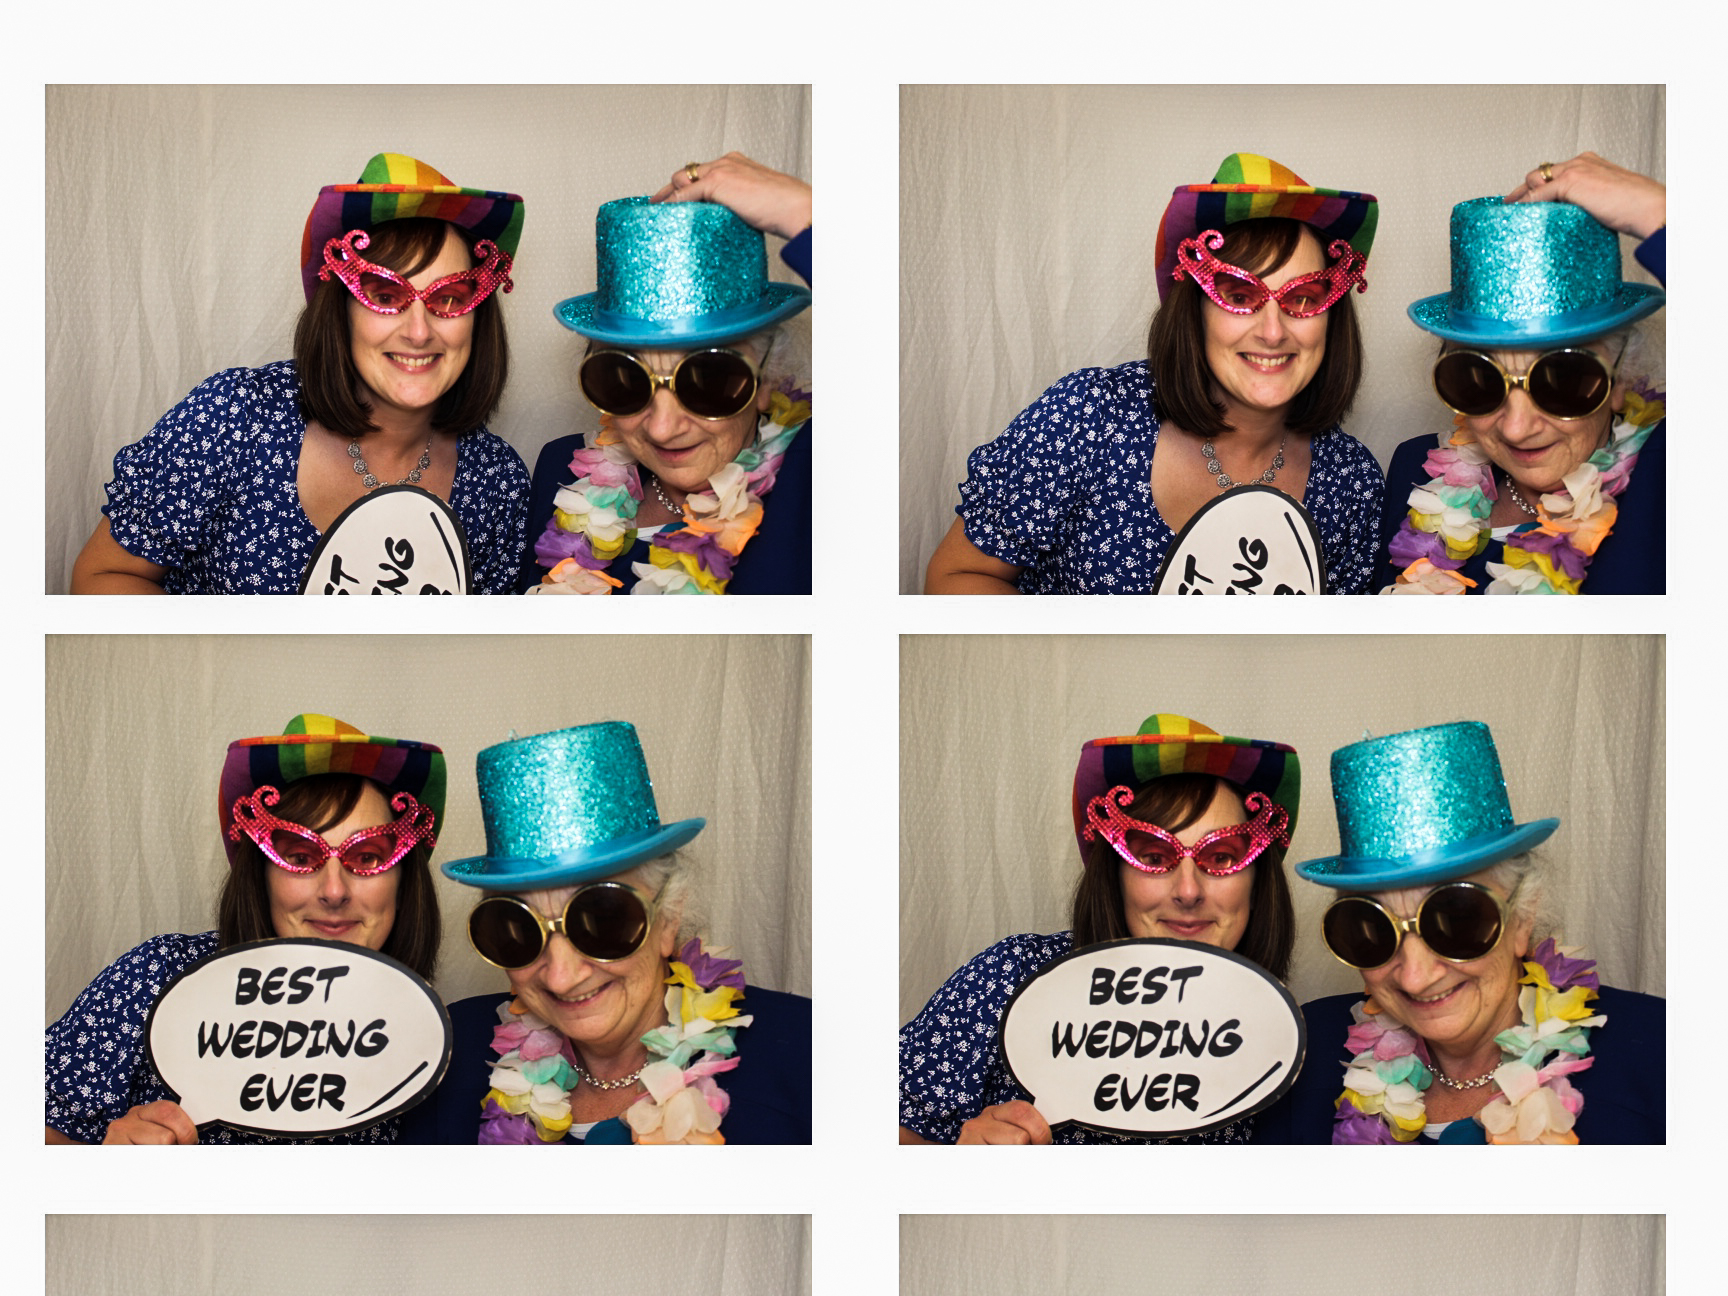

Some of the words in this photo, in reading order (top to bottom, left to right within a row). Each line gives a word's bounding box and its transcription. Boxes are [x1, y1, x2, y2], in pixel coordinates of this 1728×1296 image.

[371, 536, 415, 595] NG
[1225, 536, 1269, 595] NG
[235, 965, 350, 1005] BEST
[1089, 965, 1204, 1005] BEST
[197, 1018, 389, 1058] WEDDING
[1051, 1018, 1243, 1058] WEDDING
[239, 1073, 346, 1111] EVER
[1093, 1073, 1200, 1111] EVER
